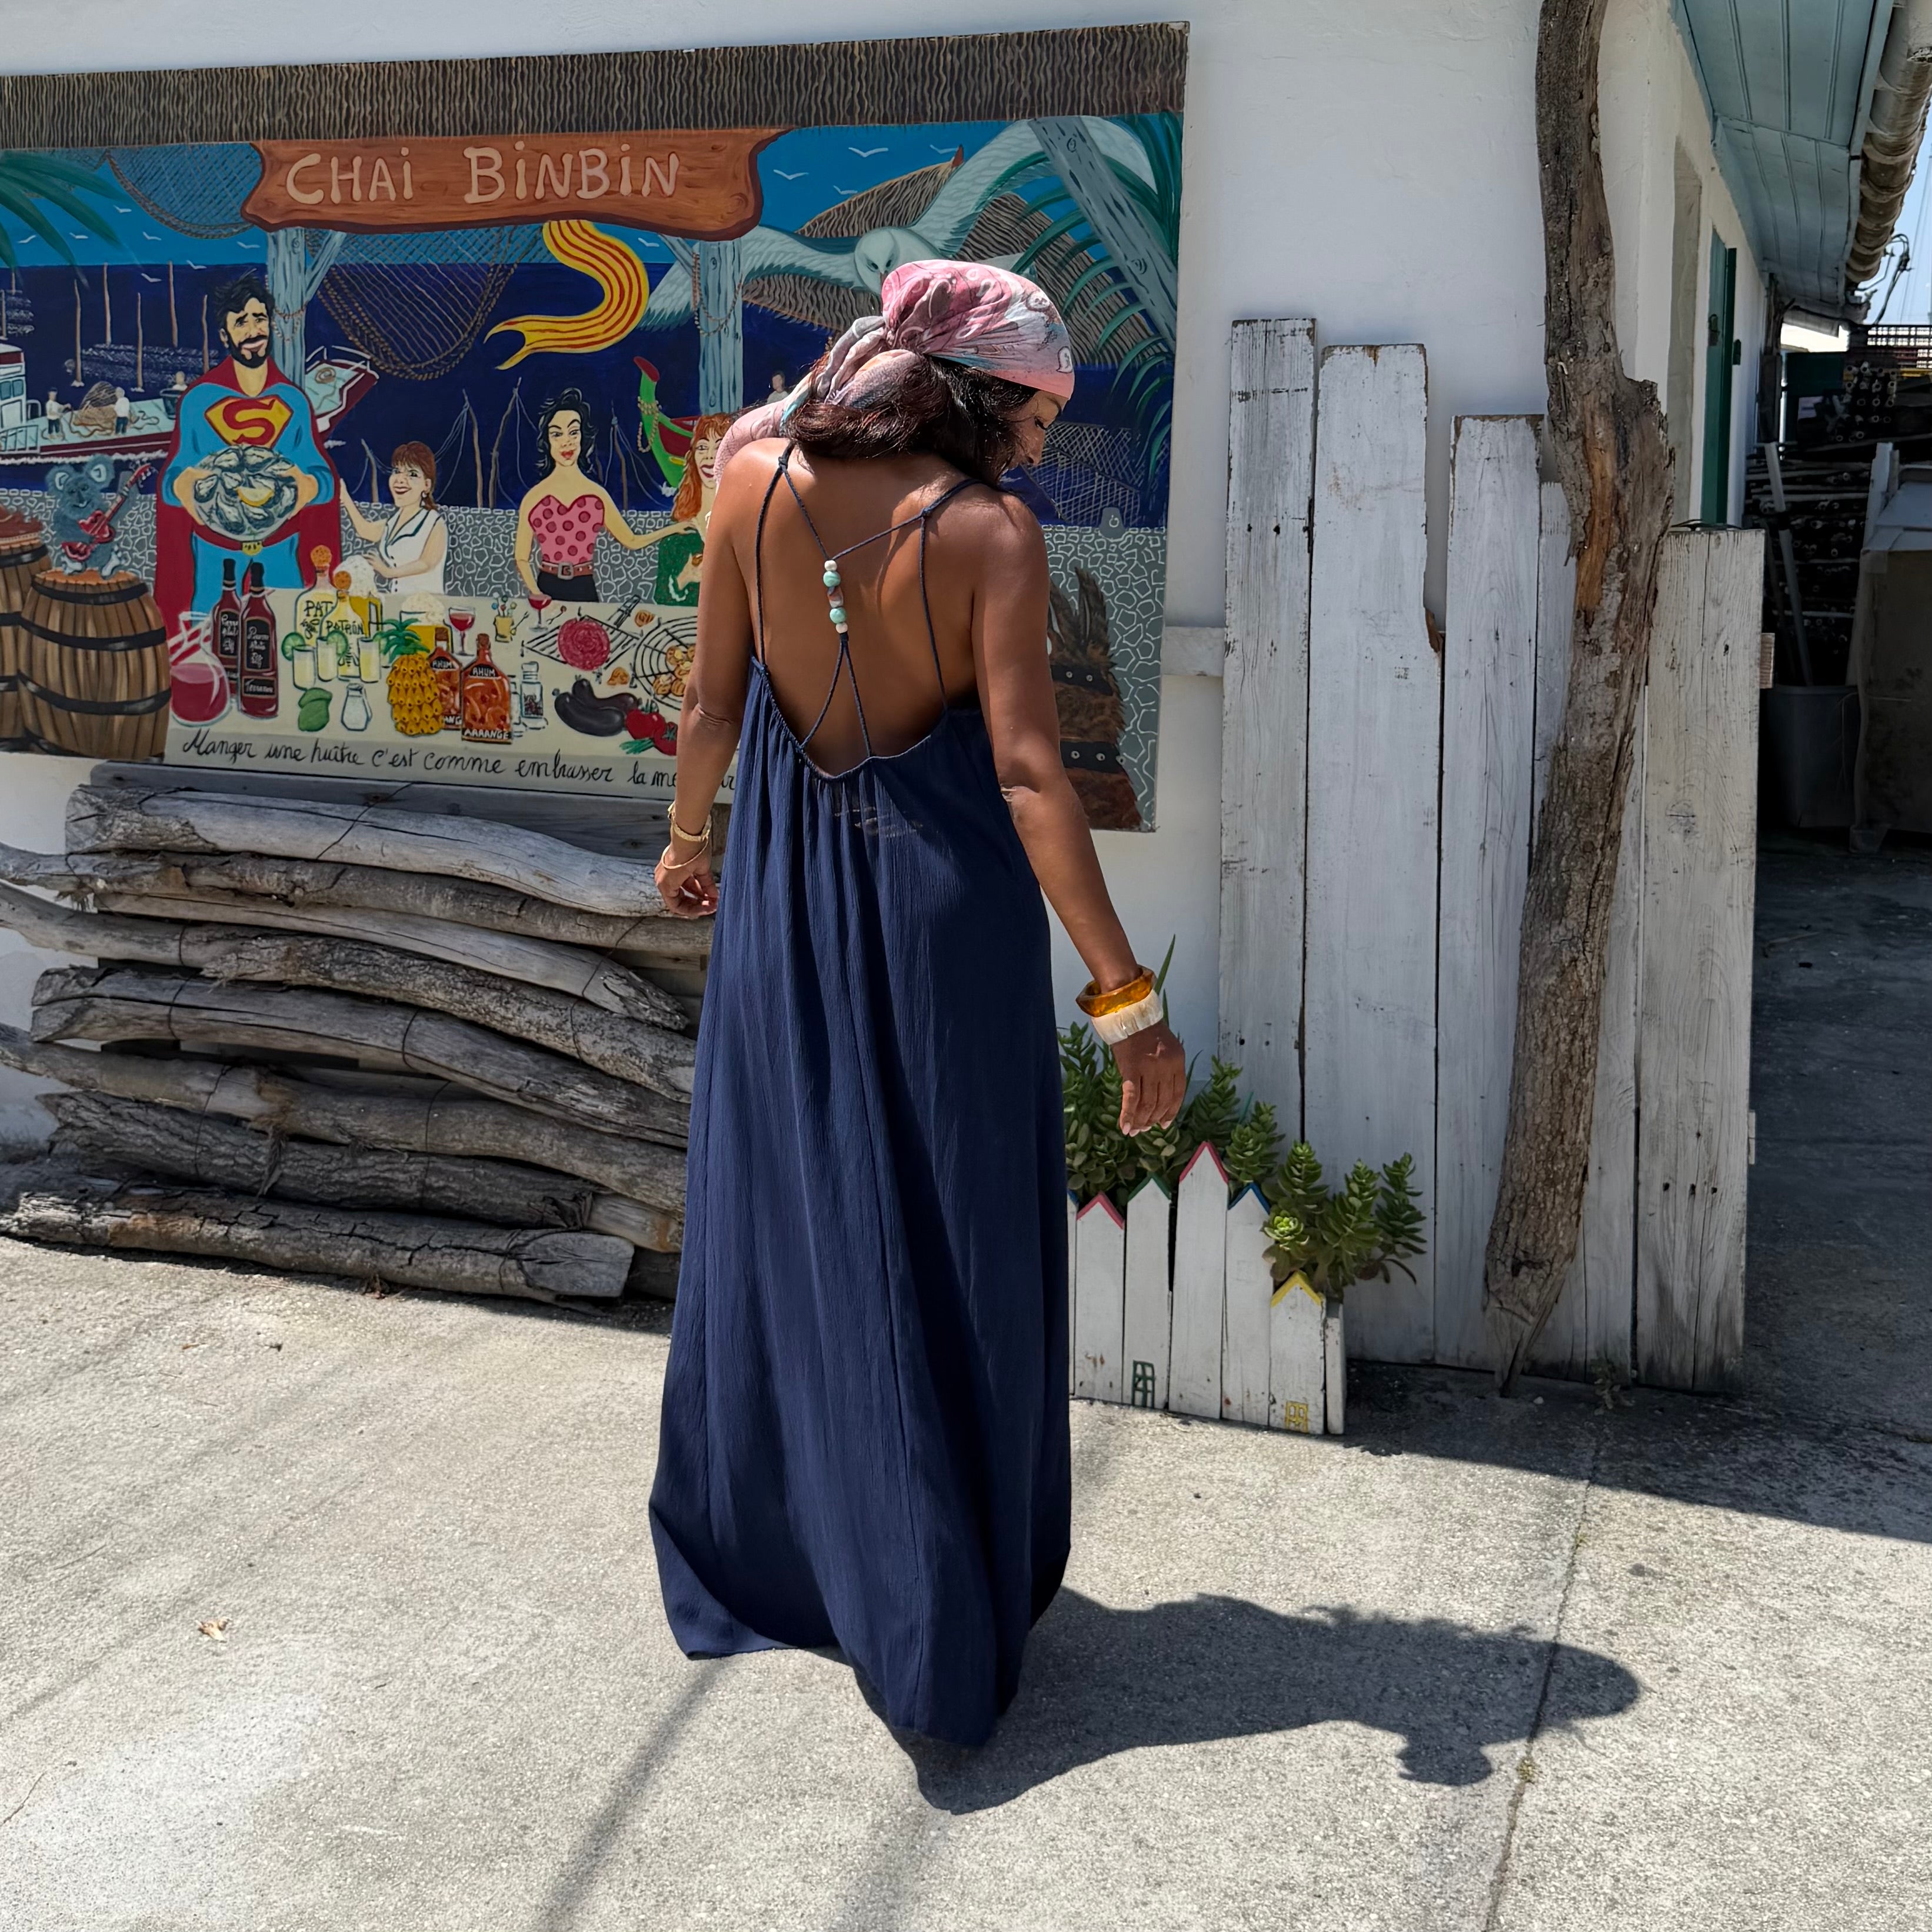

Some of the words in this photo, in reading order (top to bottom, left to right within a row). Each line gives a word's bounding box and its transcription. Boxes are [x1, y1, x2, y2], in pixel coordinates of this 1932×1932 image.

[182, 728, 257, 765] Manger
[265, 742, 307, 761] une
[311, 738, 365, 765] huître
[424, 752, 508, 774] comme
[515, 748, 615, 782] embrasser
[627, 760, 647, 785] la
